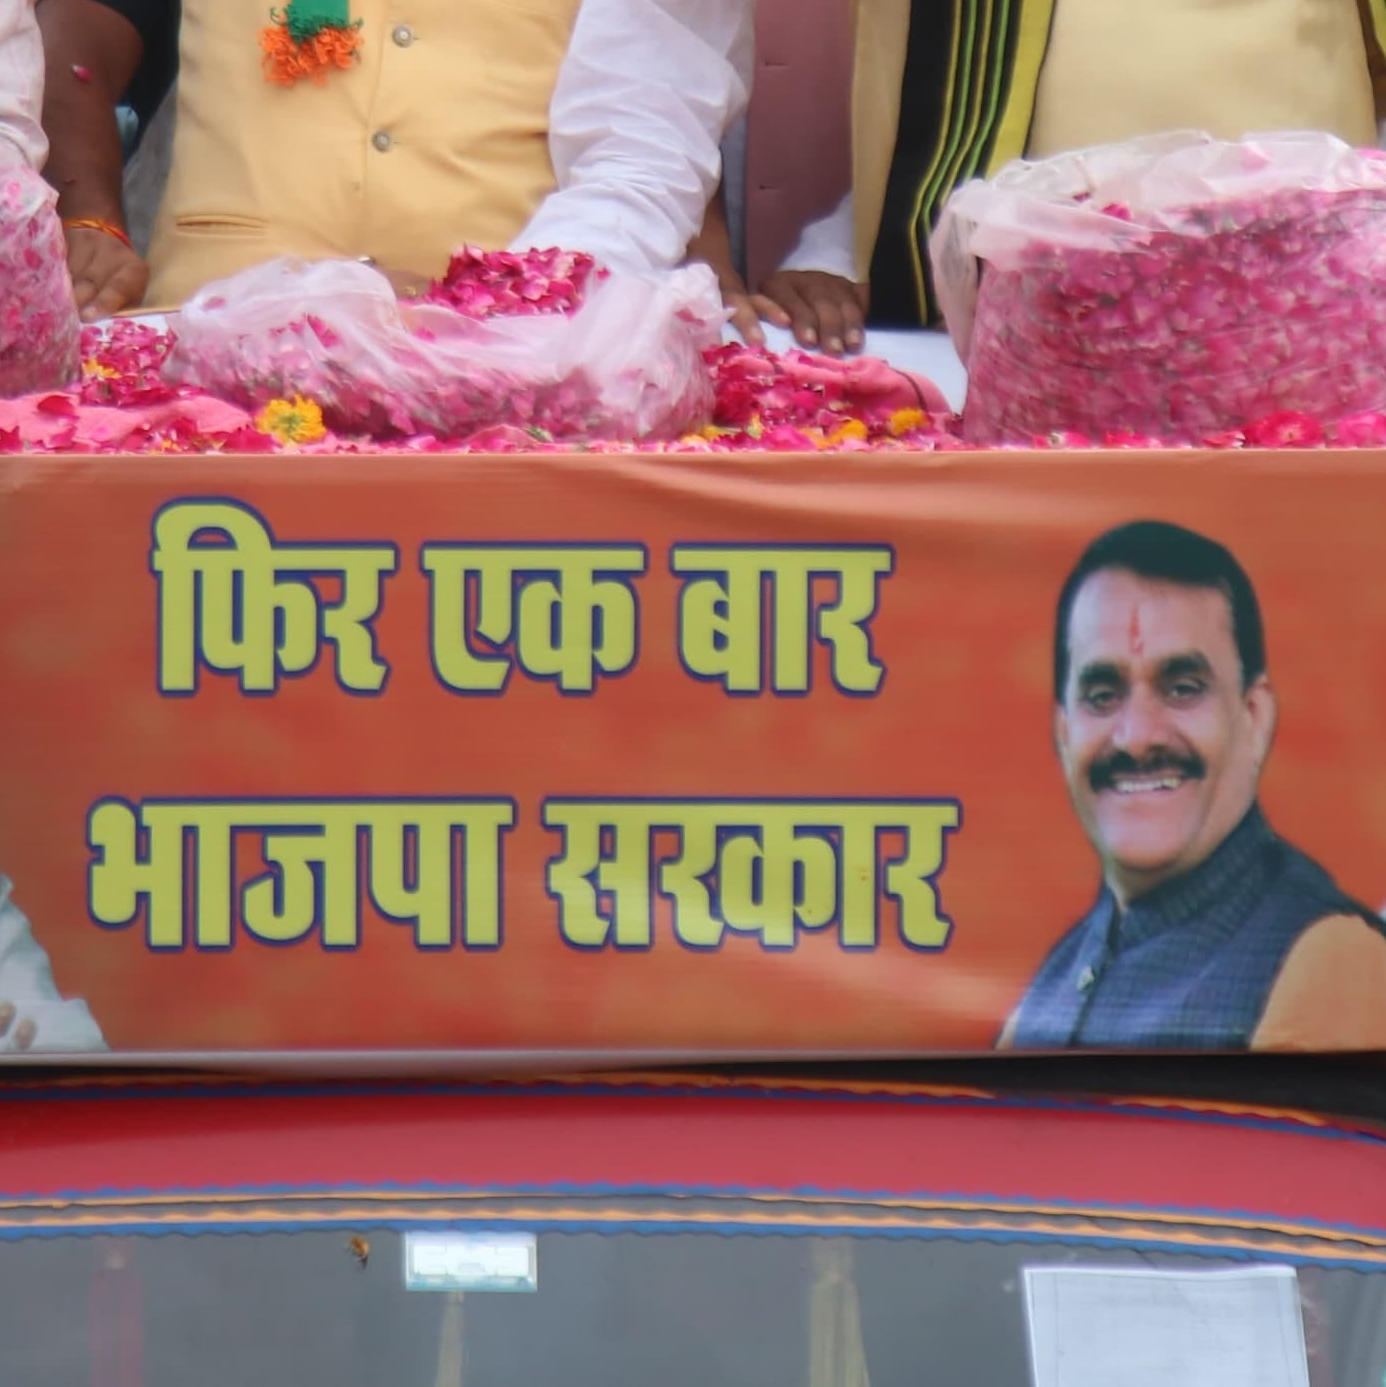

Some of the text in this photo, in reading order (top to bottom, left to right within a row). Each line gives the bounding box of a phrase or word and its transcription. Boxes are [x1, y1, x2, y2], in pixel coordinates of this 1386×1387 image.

[150, 496, 893, 696] फिर एक बार
[87, 796, 961, 952] भाजपा सरकार
